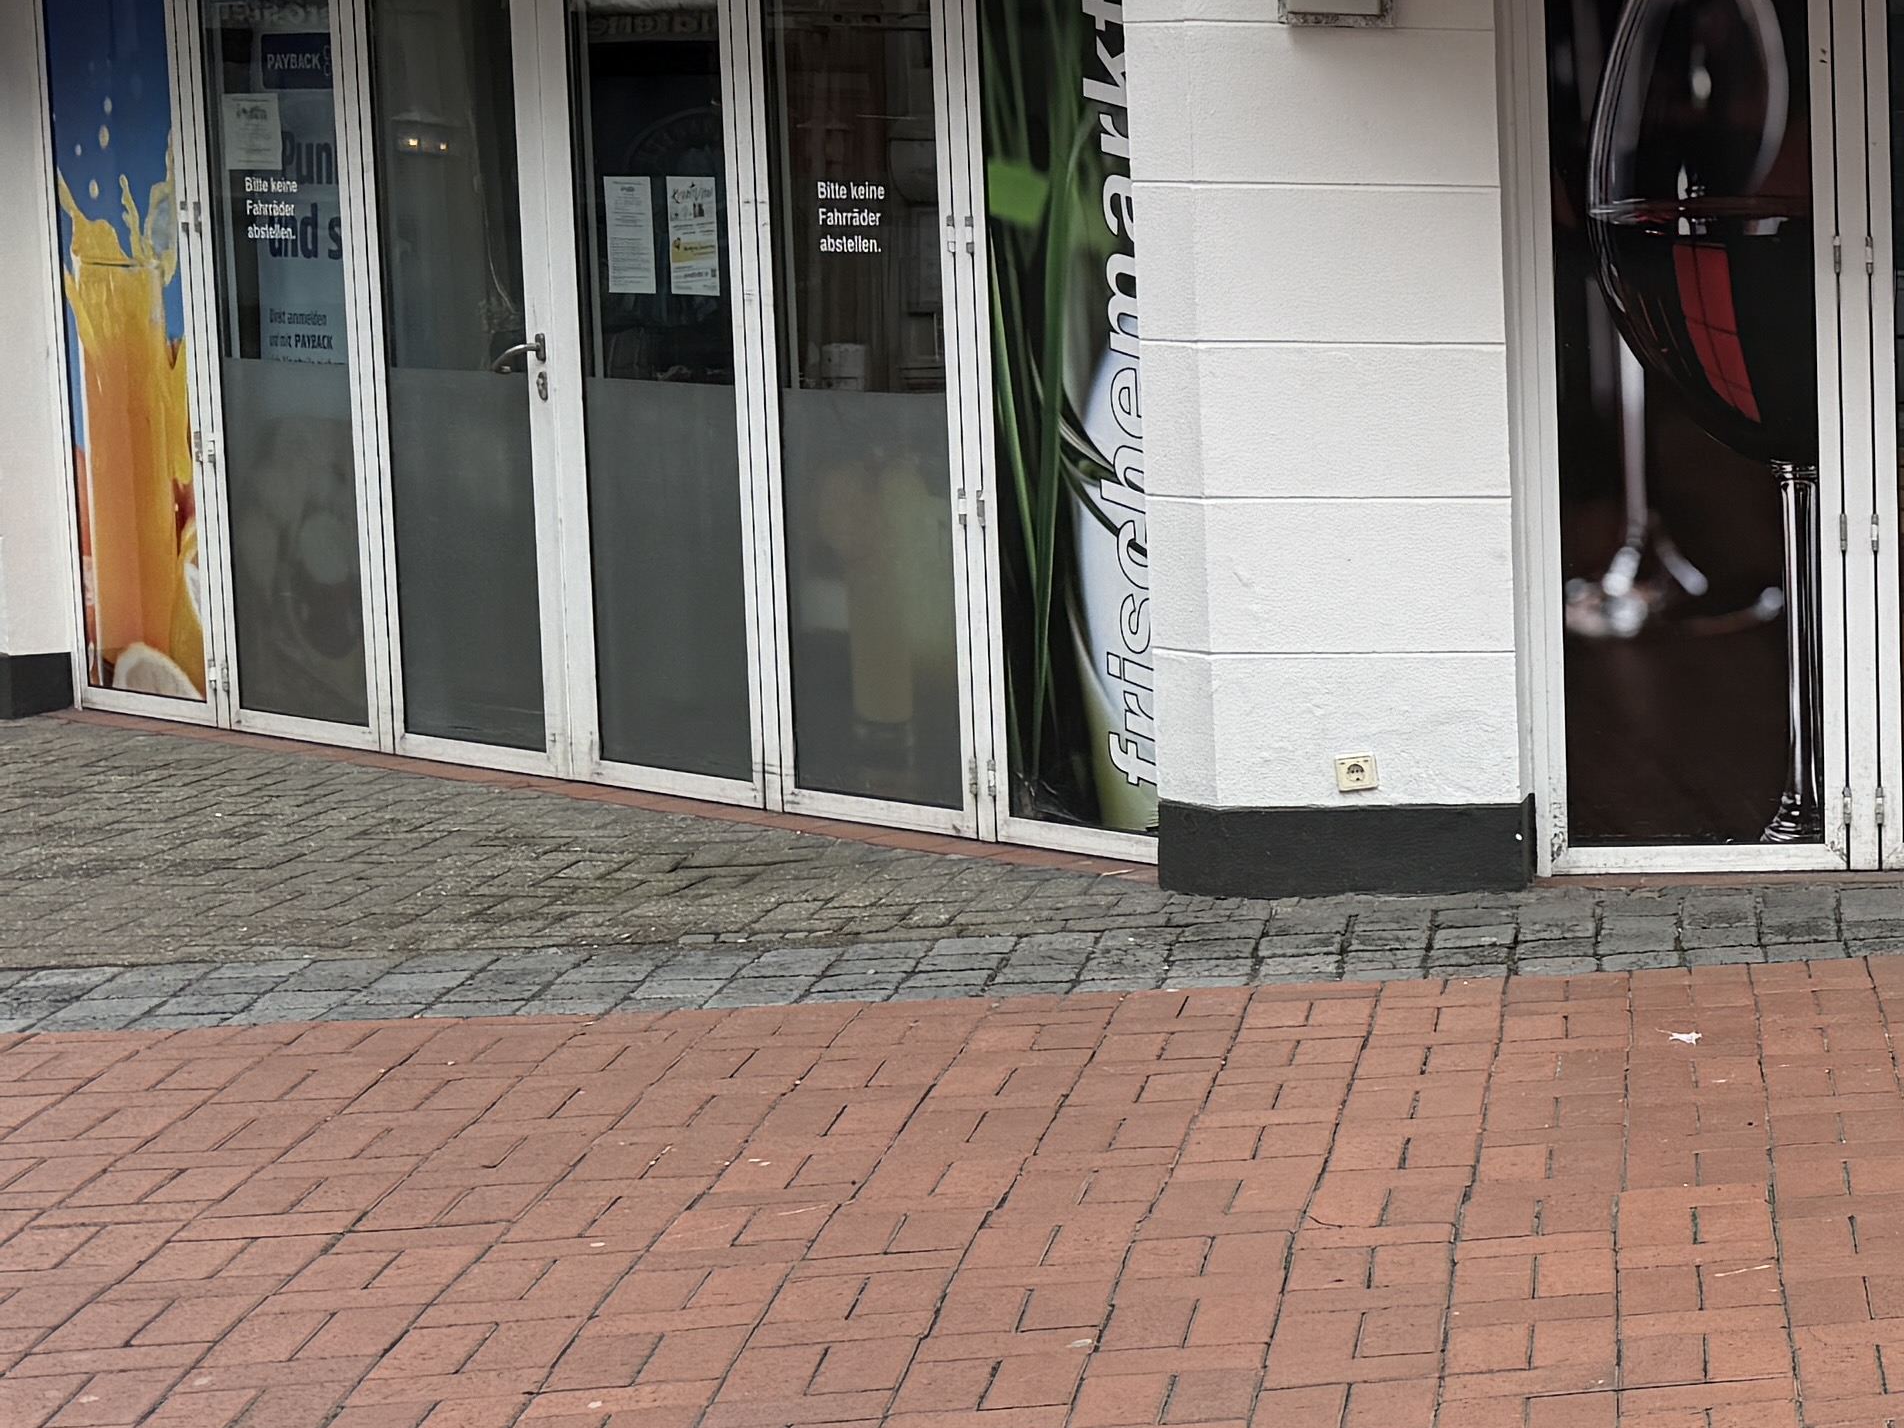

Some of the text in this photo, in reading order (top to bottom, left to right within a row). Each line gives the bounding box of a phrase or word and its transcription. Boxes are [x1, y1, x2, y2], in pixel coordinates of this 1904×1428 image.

[267, 53, 321, 70] PAYBACK
[244, 176, 298, 193] Bitte keine
[817, 181, 885, 200] Bitte keine
[246, 199, 295, 217] Fahrräder
[818, 207, 882, 226] Fahrräder
[247, 223, 297, 240] abstellen.
[819, 234, 882, 253] abstellen.
[294, 334, 333, 349] PAYBACK
